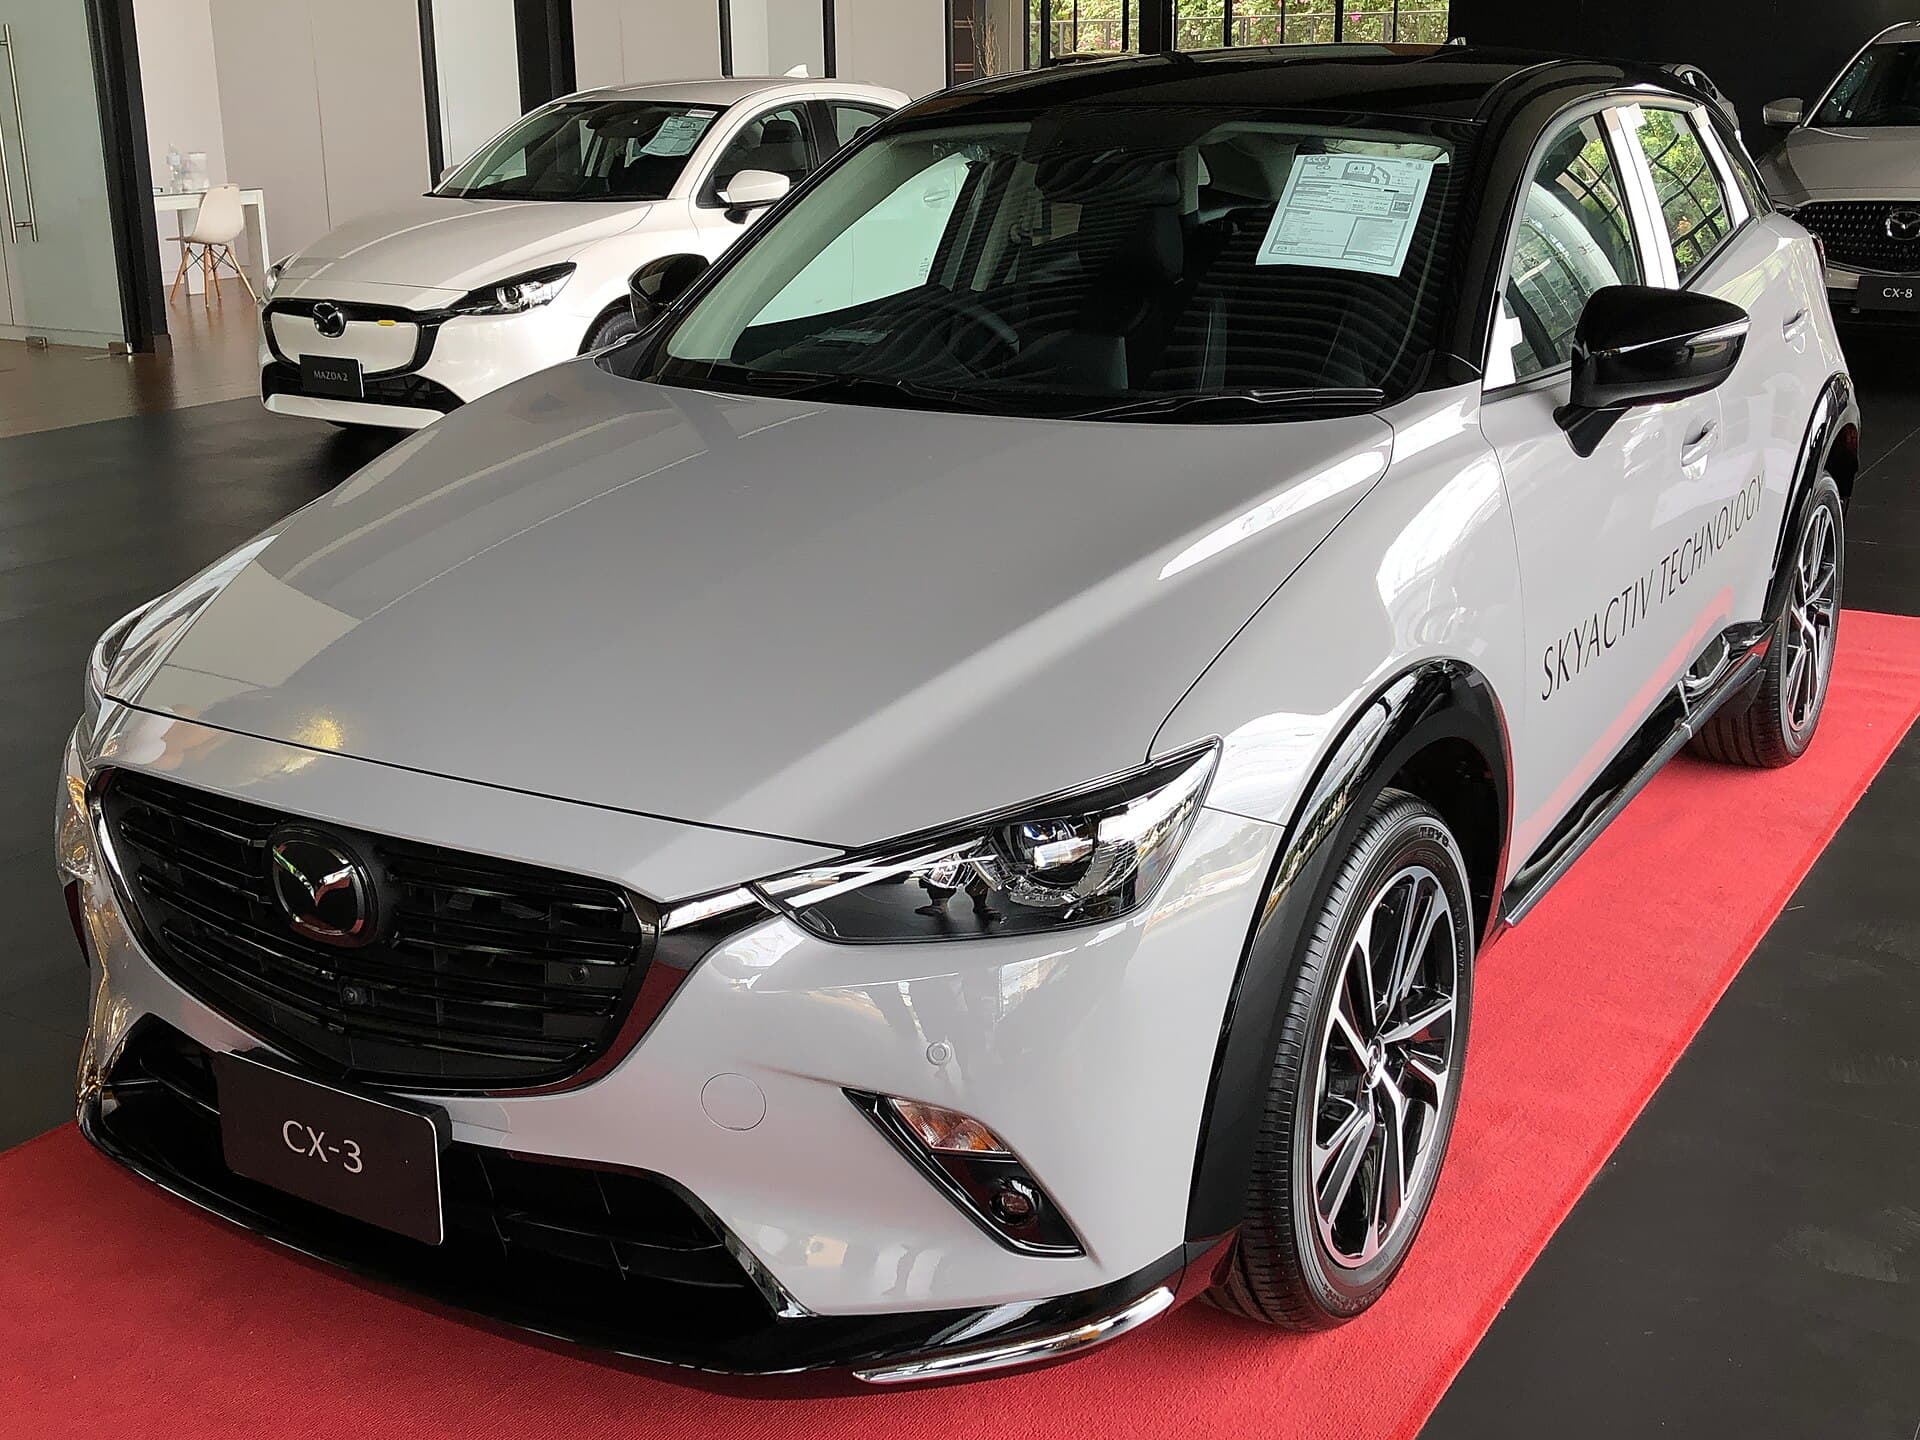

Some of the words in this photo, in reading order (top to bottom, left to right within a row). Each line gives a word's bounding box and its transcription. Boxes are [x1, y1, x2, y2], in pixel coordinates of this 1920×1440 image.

[1882, 287, 1913, 299] CX-8
[1541, 569, 1654, 701] SKYACTIV
[1660, 471, 1765, 603] TECHNOLOGY
[282, 1120, 364, 1174] CX-3
